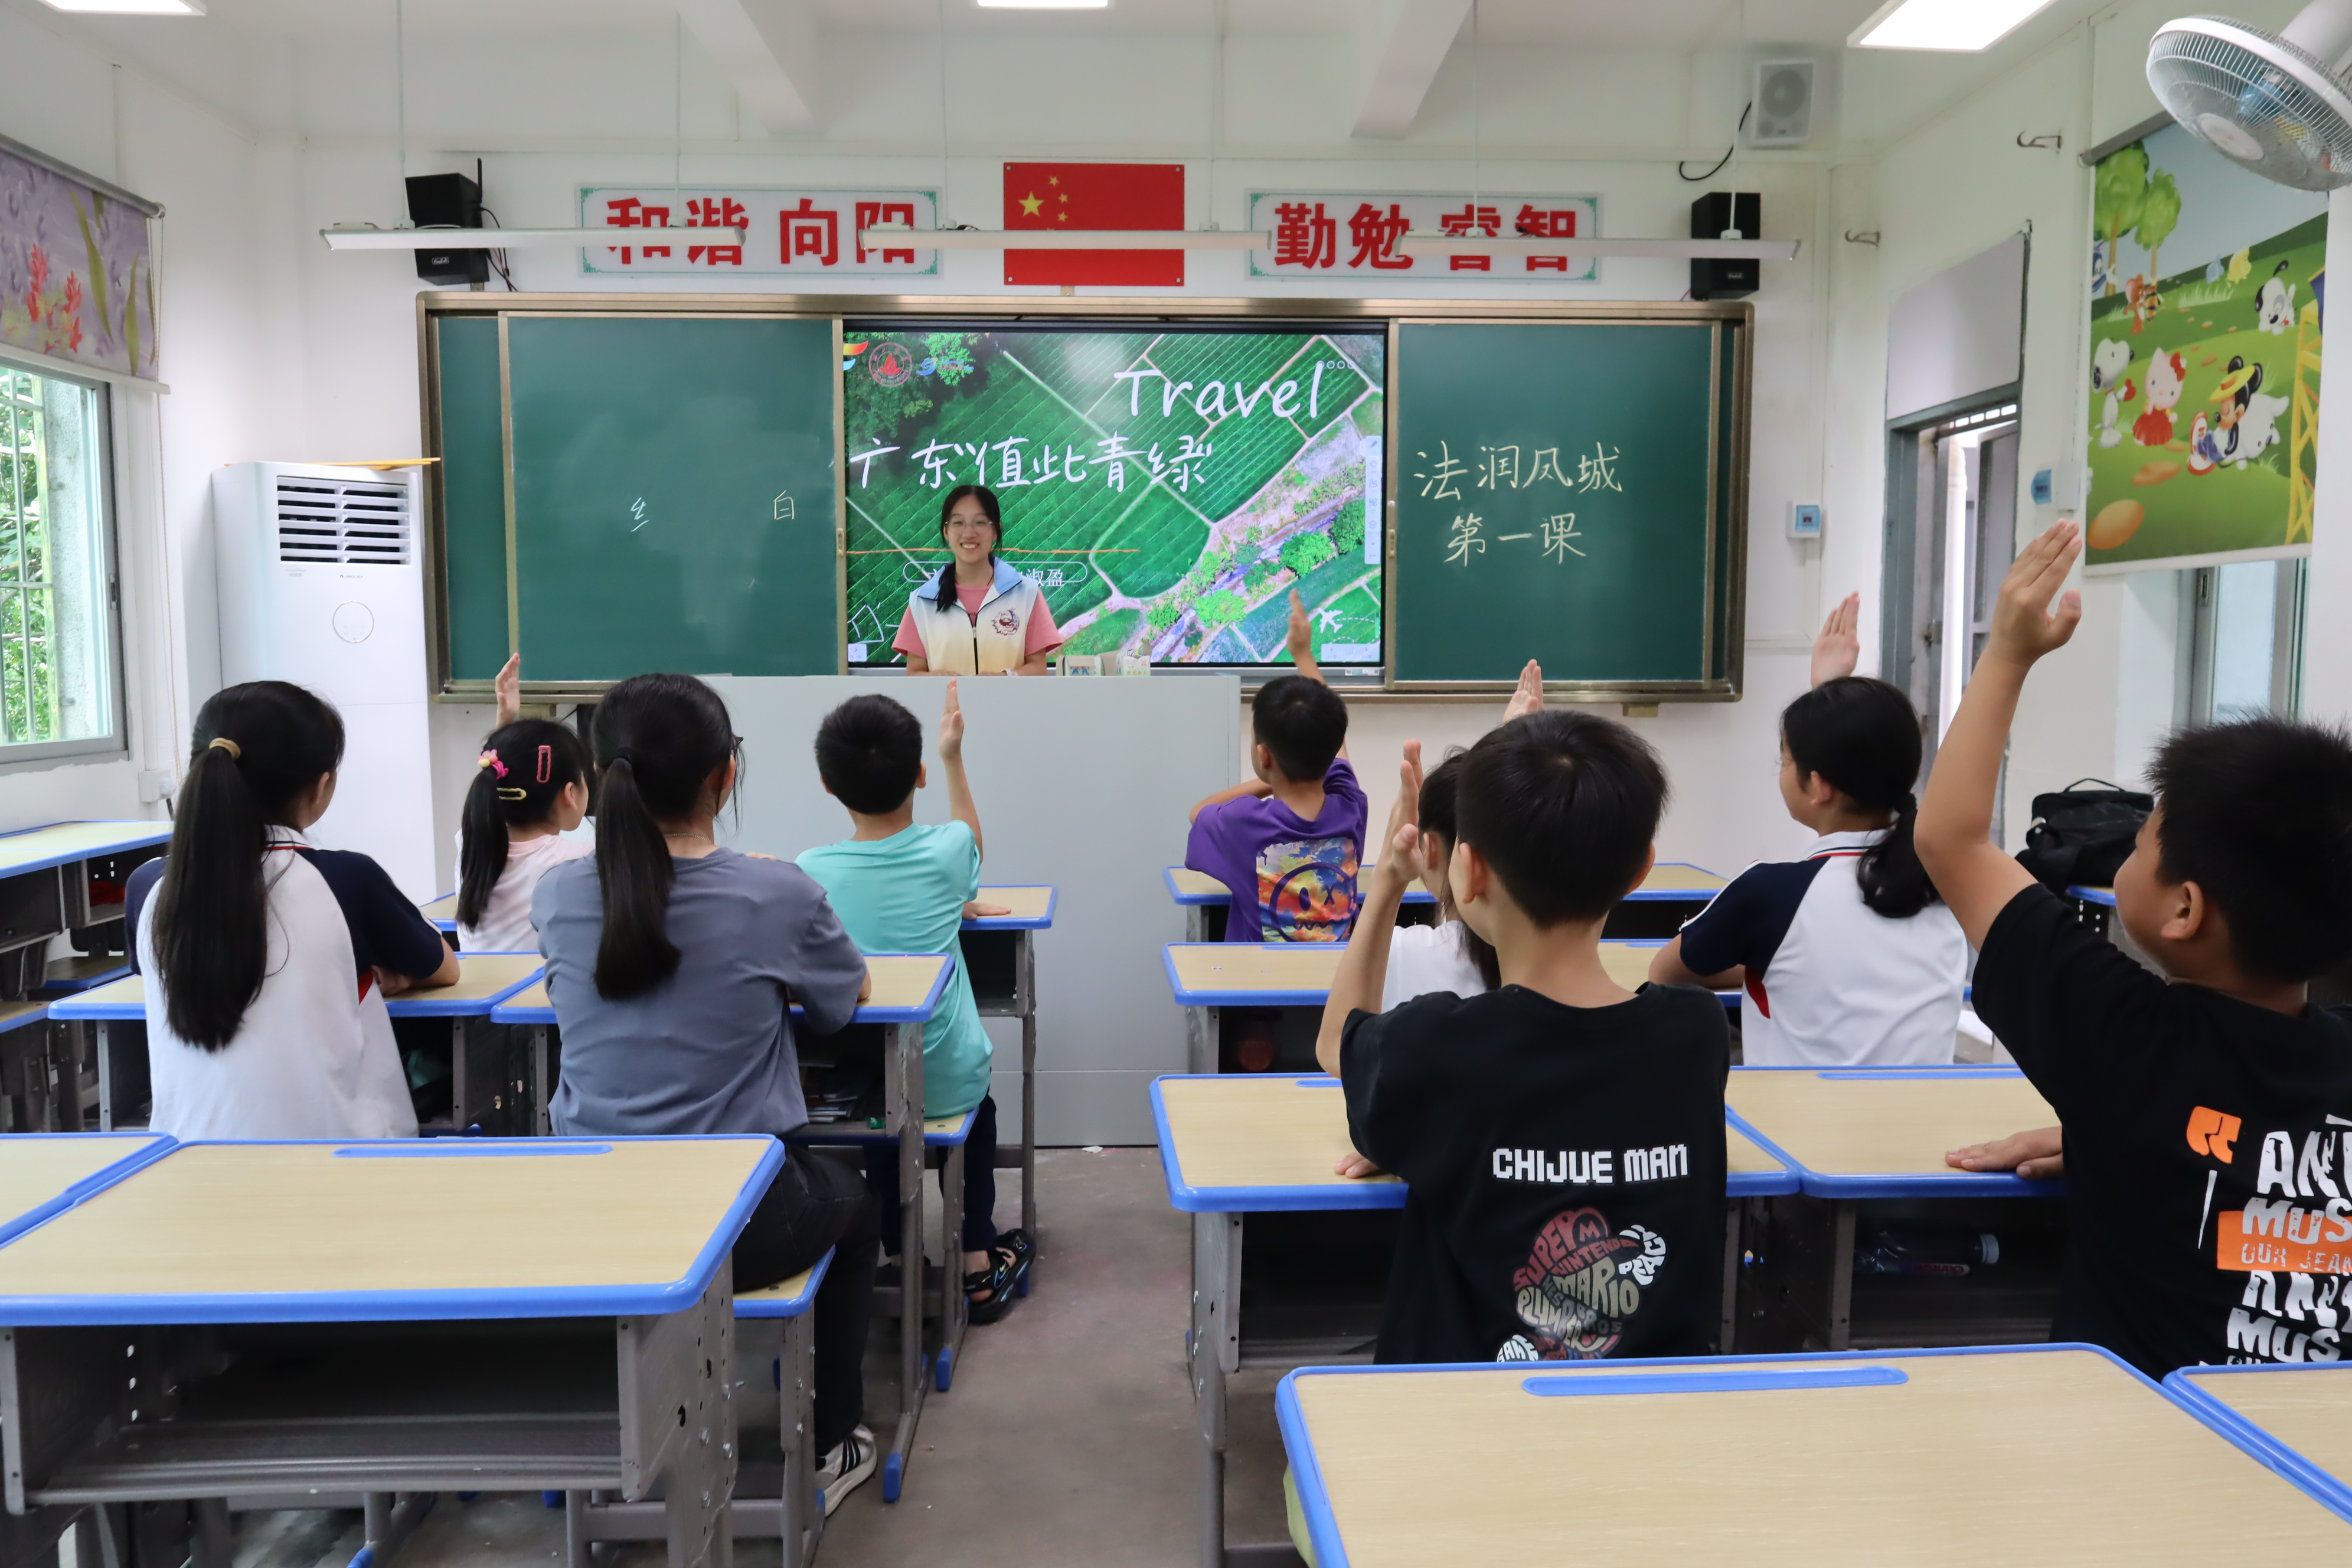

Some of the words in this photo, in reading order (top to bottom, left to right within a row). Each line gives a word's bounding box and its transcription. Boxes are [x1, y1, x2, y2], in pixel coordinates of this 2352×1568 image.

[1113, 361, 1323, 418] Travel
[1413, 440, 1622, 501] 法润凤城
[1443, 512, 1586, 567] 第一课
[1492, 1148, 1613, 1183] CHIJUE
[1624, 1144, 1688, 1181] MAN
[1552, 1256, 1639, 1318] MARIO
